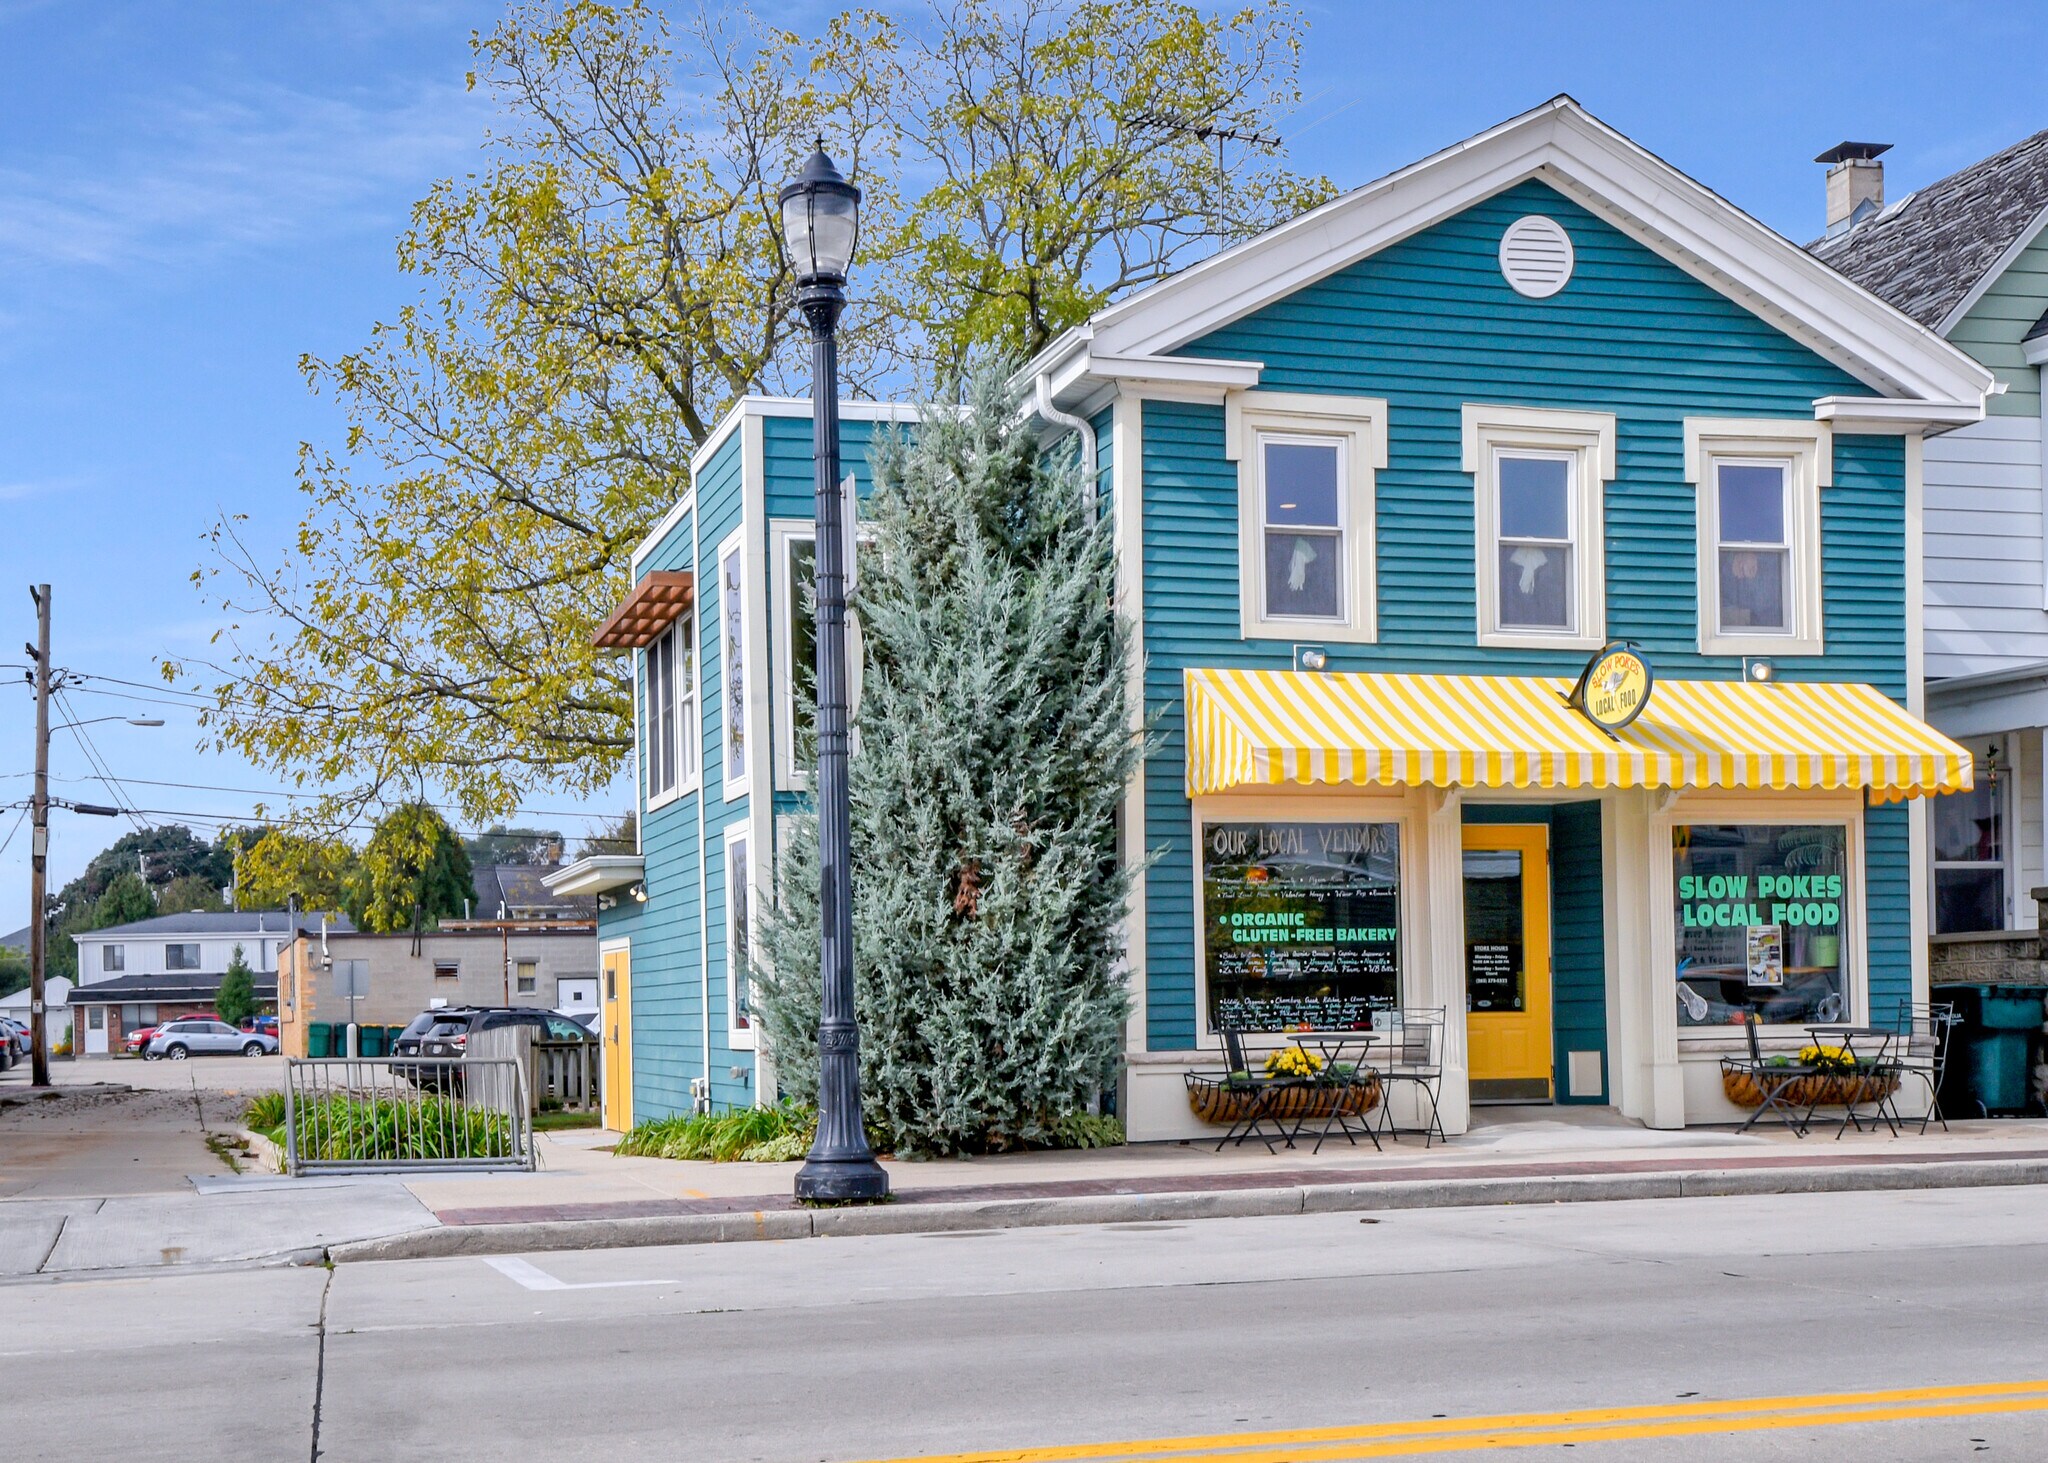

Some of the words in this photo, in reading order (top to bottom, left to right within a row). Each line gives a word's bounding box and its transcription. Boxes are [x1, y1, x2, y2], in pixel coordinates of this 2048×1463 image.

[1592, 658, 1613, 688] SLOW
[1615, 656, 1640, 675] POKES
[1596, 696, 1615, 716] LOCAL
[1620, 689, 1636, 709] FOOD
[1213, 828, 1247, 855] OUR
[1258, 828, 1309, 855] LOCAL
[1318, 826, 1388, 853] VENDORS
[1679, 875, 1748, 899] SLOW
[1758, 875, 1842, 899] POKES
[1231, 913, 1305, 926] ORGANIC
[1683, 903, 1763, 928] LOCAL
[1771, 903, 1840, 926] FOOD
[1232, 928, 1334, 942] GLUTEN-FREE
[1336, 927, 1397, 941] BAKERY
